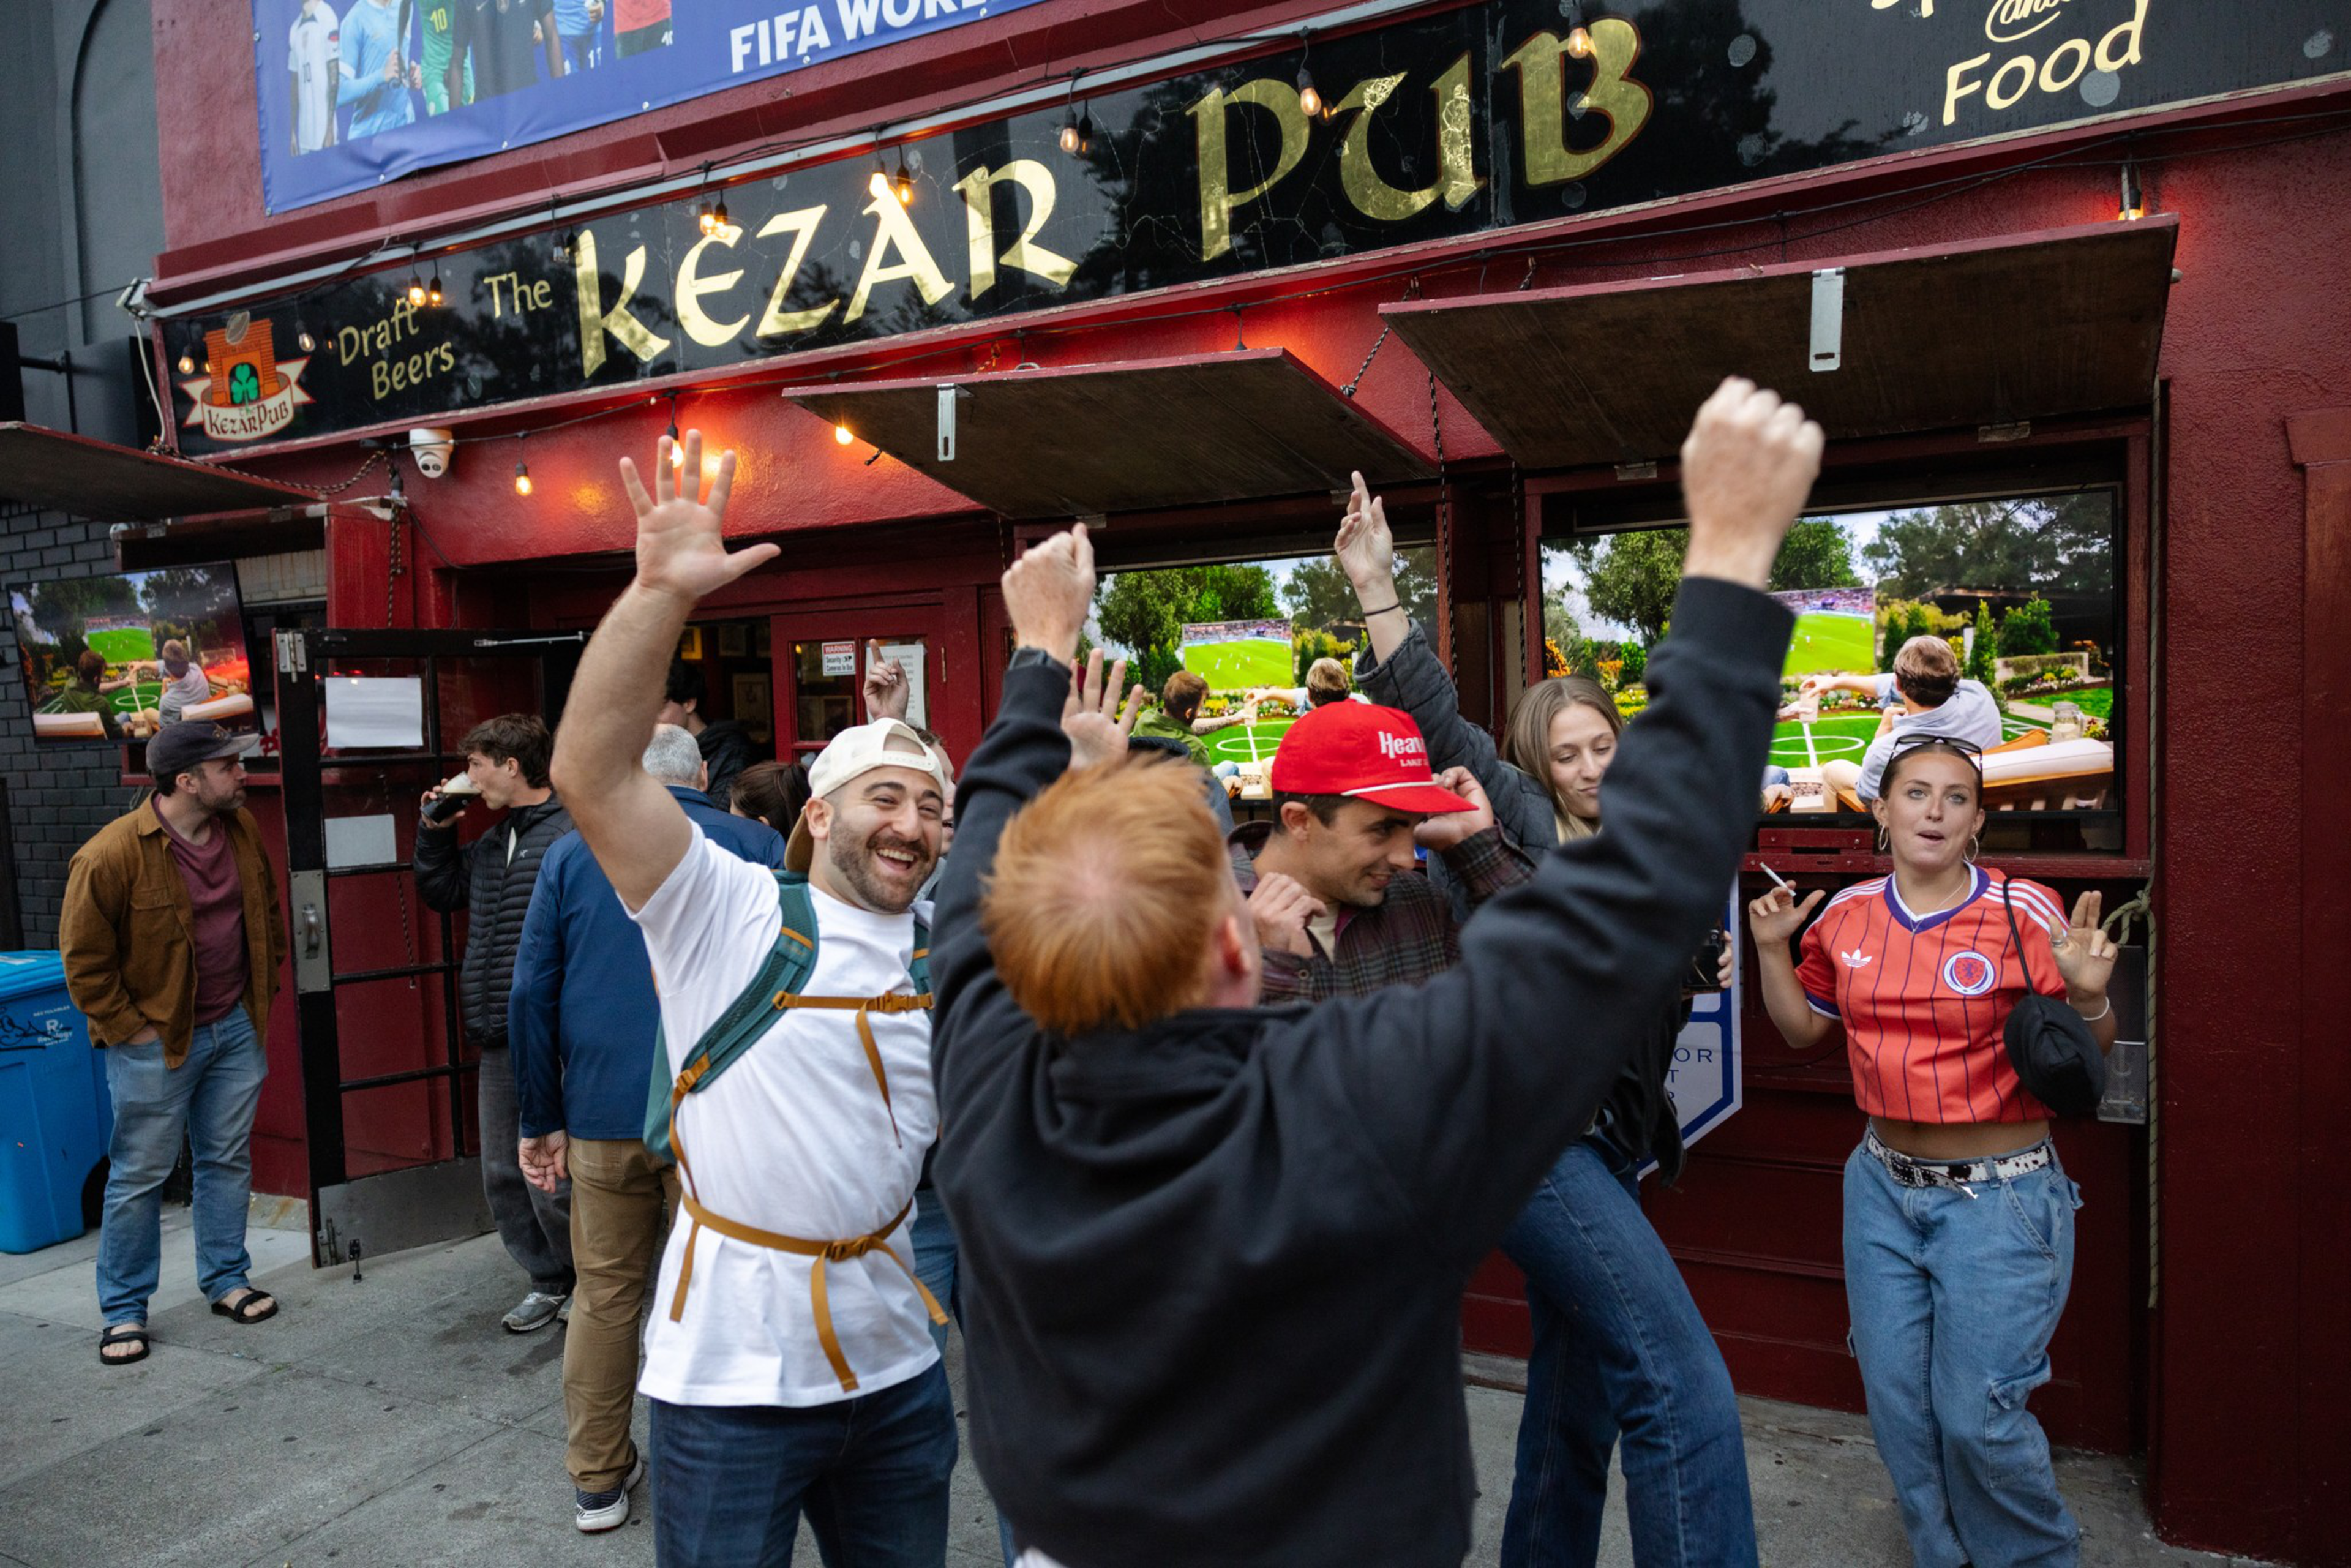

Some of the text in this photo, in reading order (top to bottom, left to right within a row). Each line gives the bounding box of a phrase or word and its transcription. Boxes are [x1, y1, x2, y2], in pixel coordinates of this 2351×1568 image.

[430, 7, 448, 33] 10
[730, 5, 830, 73] FIFA
[303, 62, 312, 83] 10
[1943, 0, 2151, 126] Food
[483, 17, 1654, 379] The KEZAR PUB
[338, 296, 419, 366] Draft
[372, 342, 455, 400] Beers
[825, 644, 853, 653] WARNING
[1400, 759, 1422, 767] LAKE
